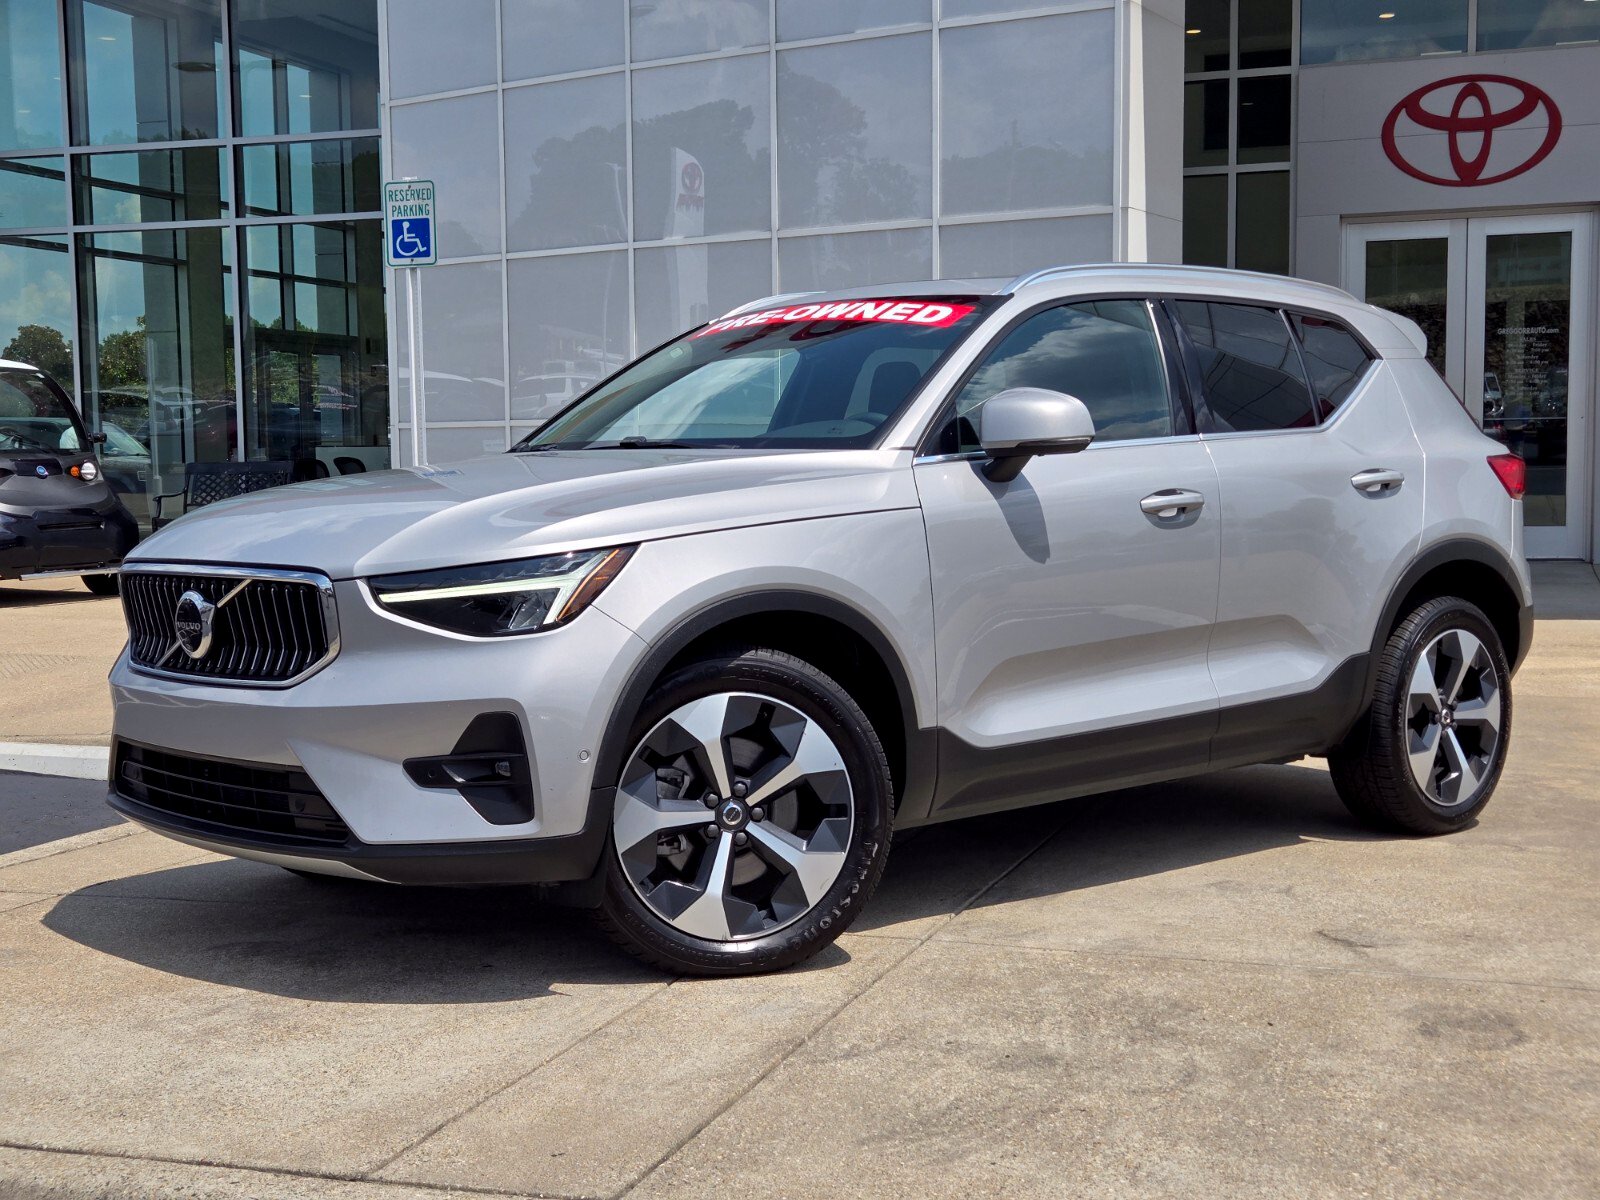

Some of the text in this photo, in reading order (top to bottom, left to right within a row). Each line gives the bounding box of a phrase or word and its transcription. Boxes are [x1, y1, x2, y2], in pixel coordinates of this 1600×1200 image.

[388, 188, 432, 202] RESERVED
[391, 204, 430, 217] PARKING
[696, 301, 953, 337] PRE-OWNED
[177, 621, 201, 630] VOLVO
